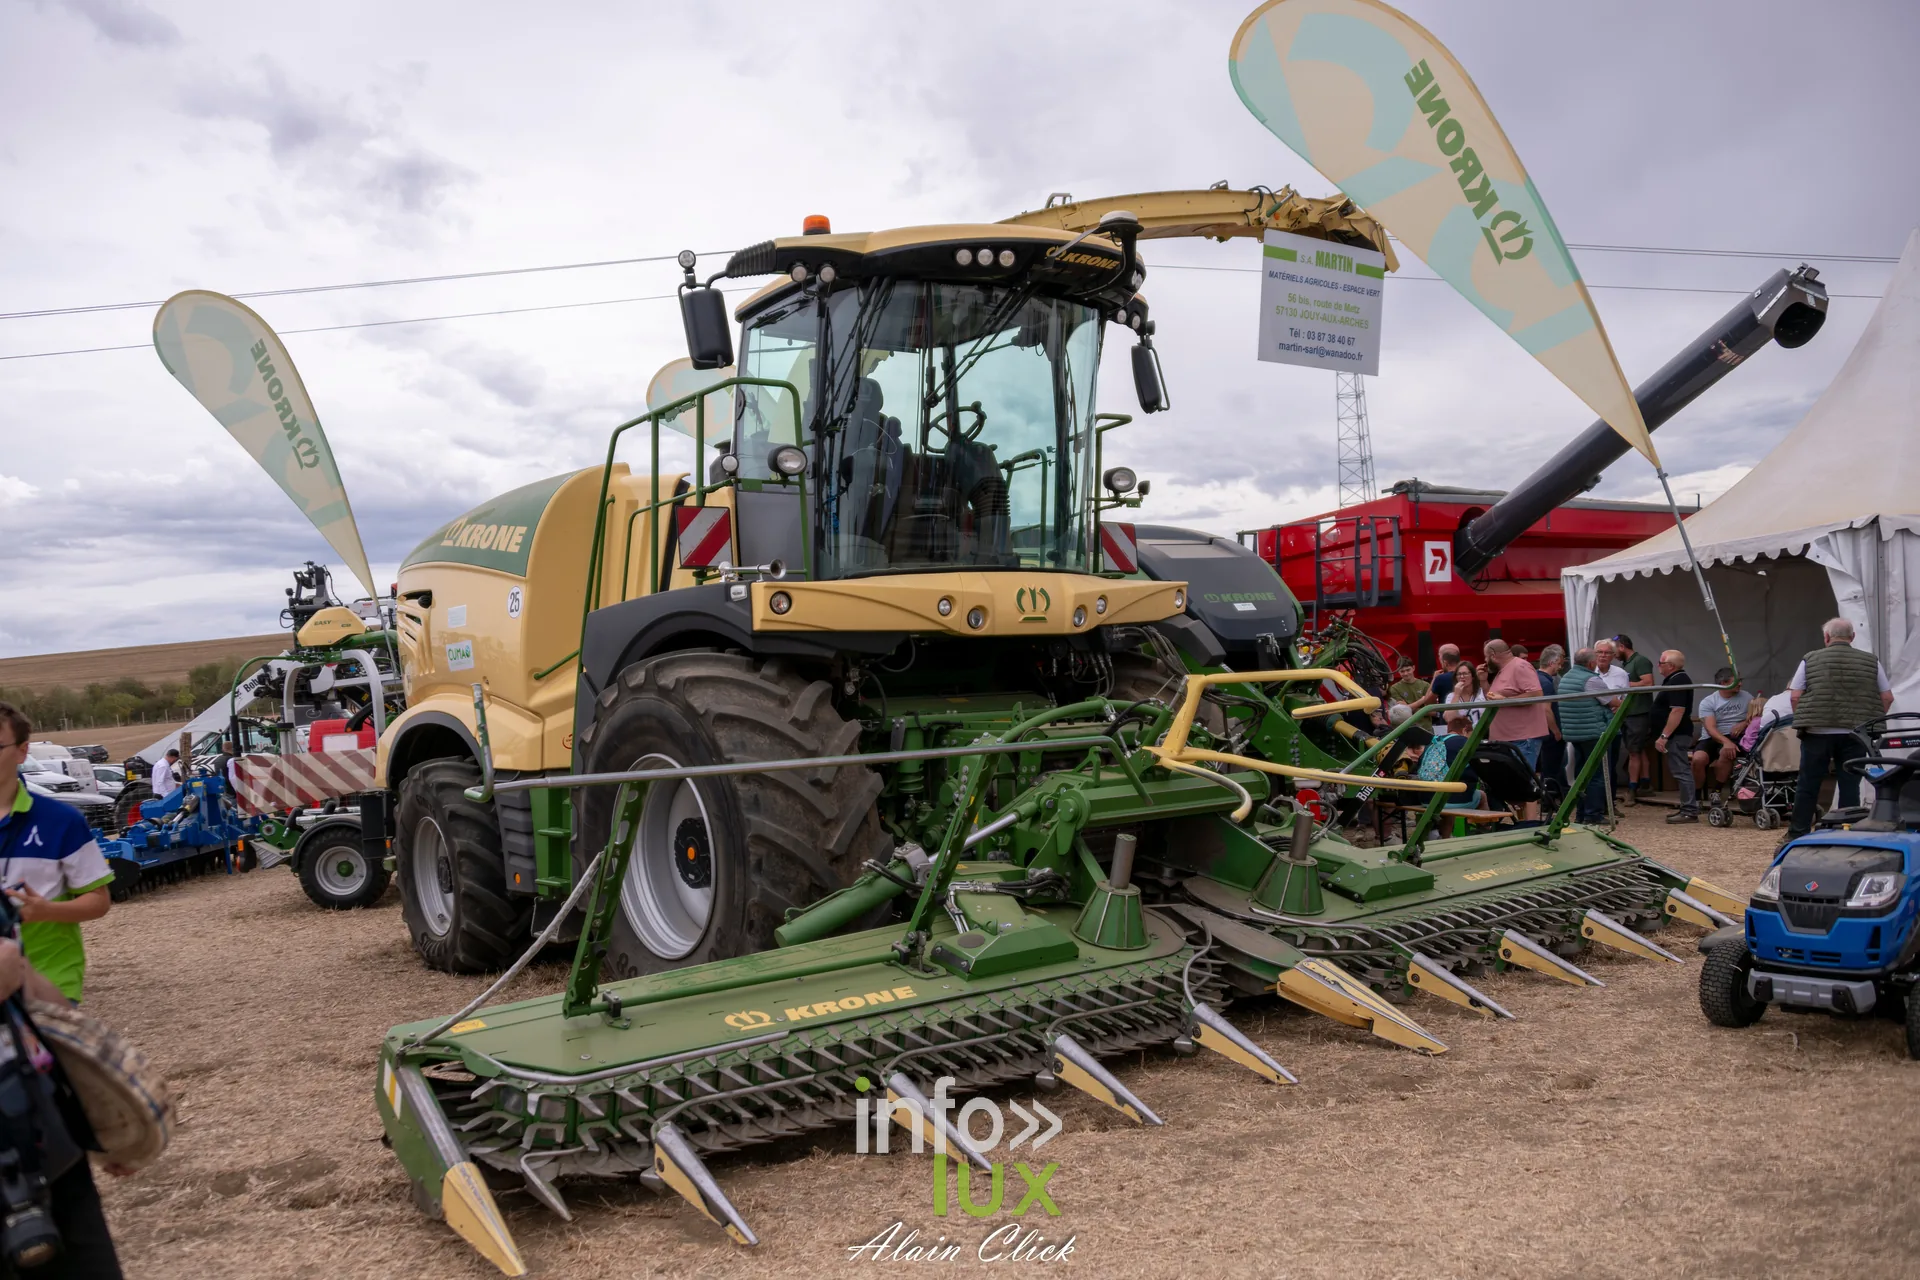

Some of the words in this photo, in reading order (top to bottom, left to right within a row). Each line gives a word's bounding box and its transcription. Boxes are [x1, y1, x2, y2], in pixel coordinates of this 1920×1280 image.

[1063, 252, 1121, 270] KRONE
[1300, 254, 1314, 265] S.A.
[1315, 250, 1353, 273] MARTIN
[1269, 270, 1304, 283] MATÉRIELS
[1304, 278, 1339, 290] AGRICOLES
[1343, 284, 1365, 295] ESPACE
[1366, 289, 1380, 298] VERT
[1288, 293, 1296, 303] 56
[1314, 298, 1332, 308] route
[1334, 300, 1342, 310] de
[1344, 303, 1360, 314] Metz
[1276, 306, 1298, 317] 57130
[1300, 308, 1369, 329] JOUY-AUX-ARCHES
[1289, 328, 1300, 338] Tél
[1306, 330, 1315, 340] 03
[1317, 332, 1325, 342] 87
[1328, 334, 1336, 344] 38
[1337, 336, 1346, 345] 40
[1347, 337, 1355, 346] 67
[454, 524, 528, 553] KRONE
[510, 591, 520, 612] 25
[1220, 592, 1276, 602] KRONE
[784, 986, 918, 1021] KRONE
